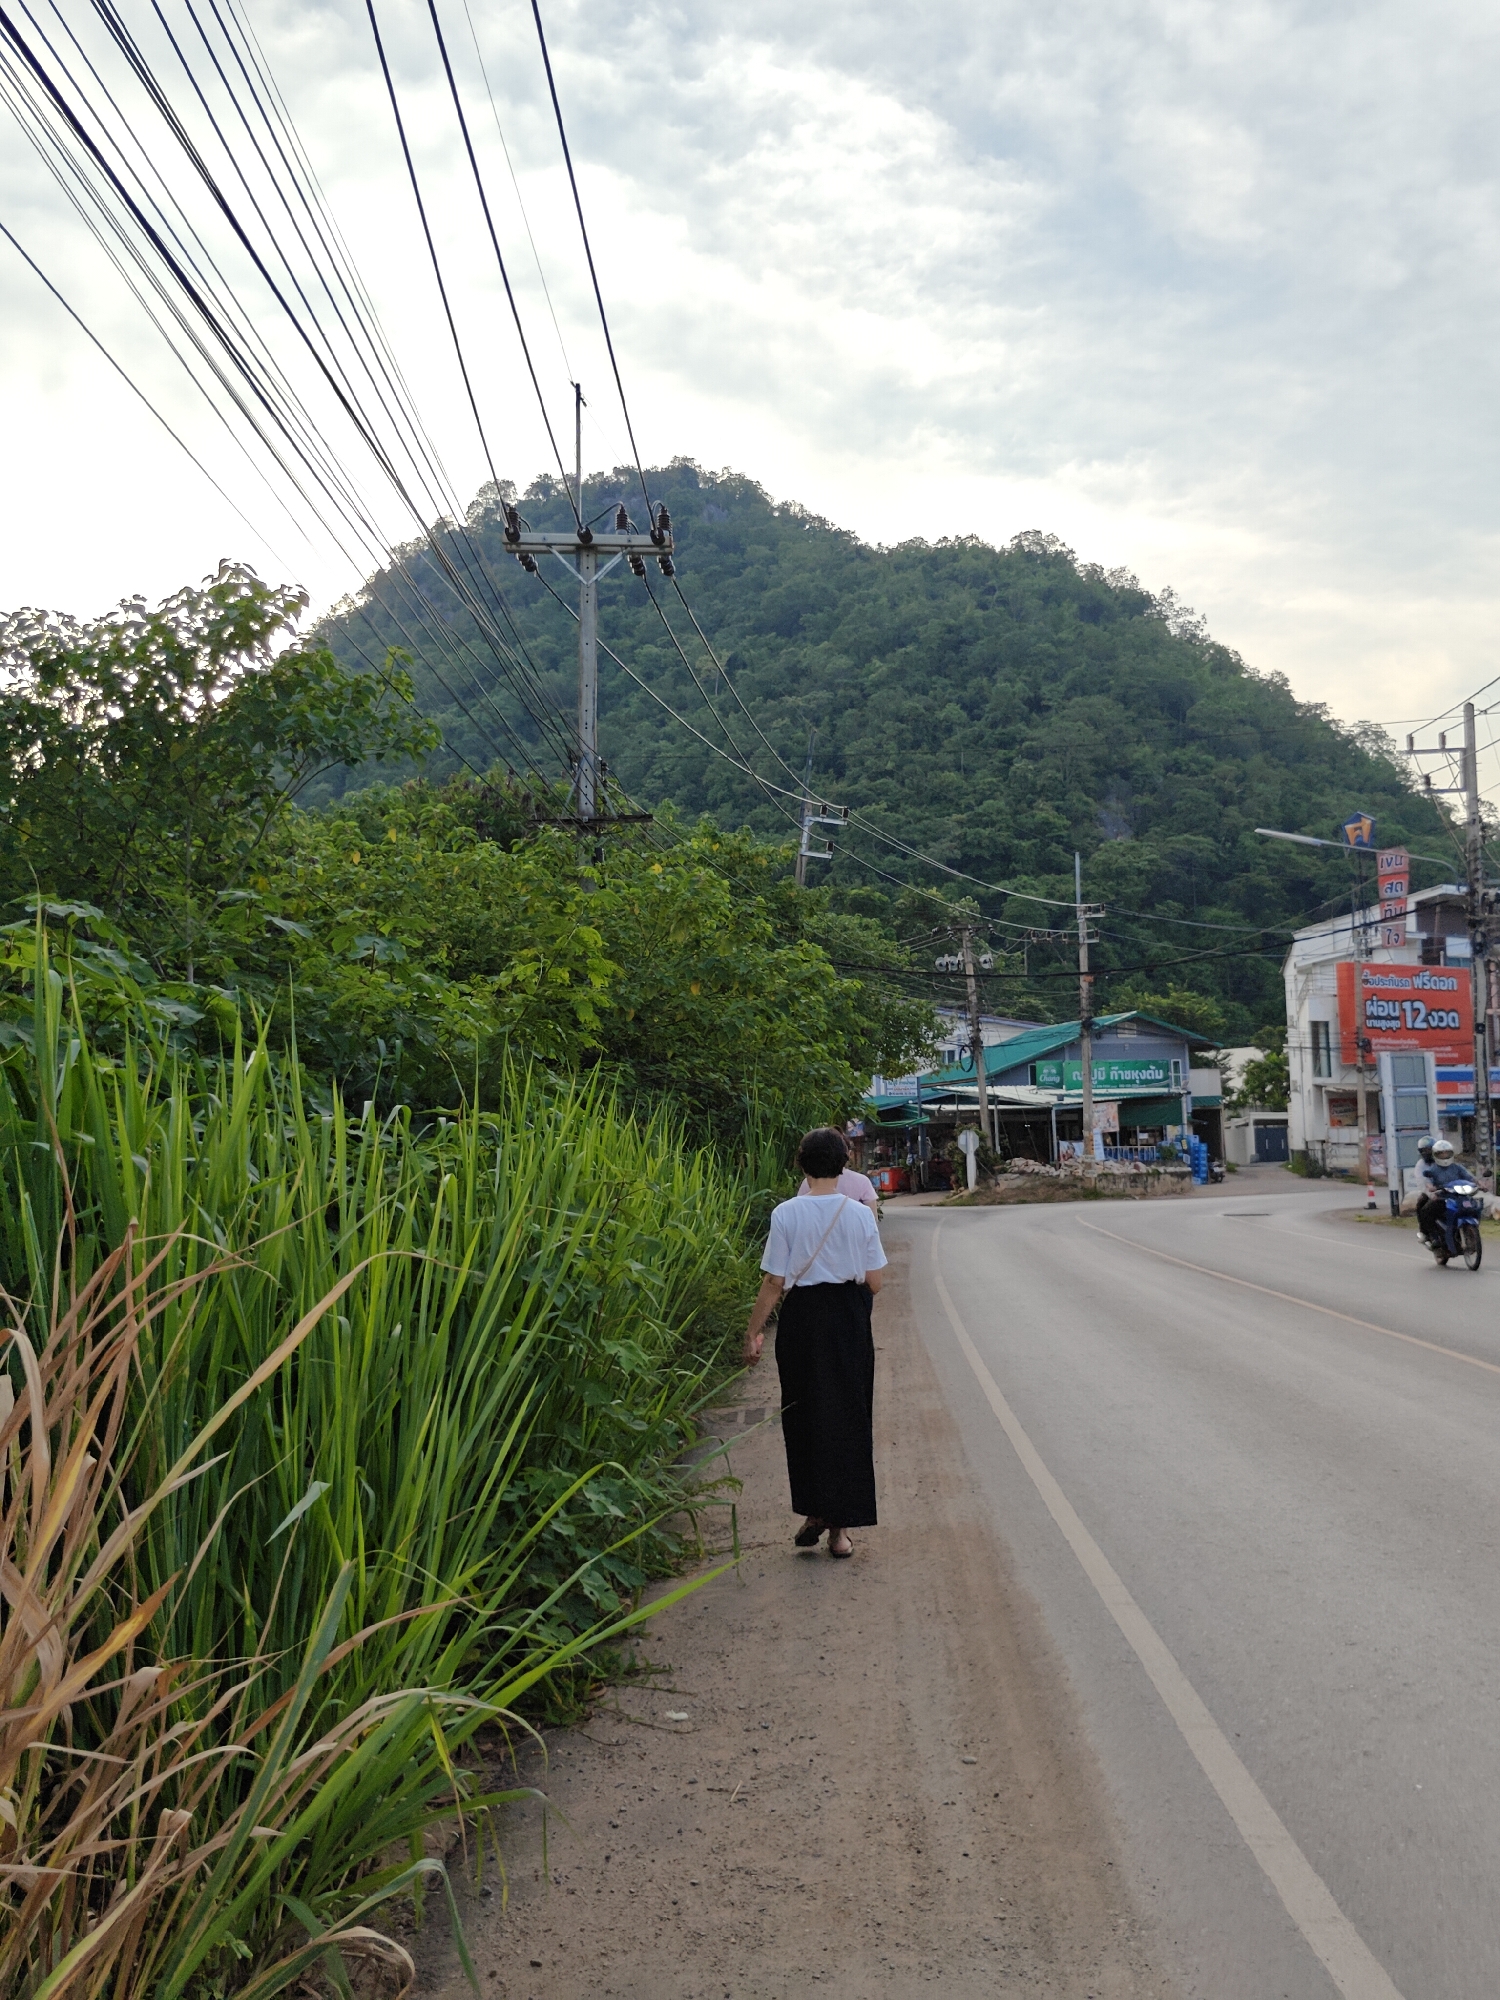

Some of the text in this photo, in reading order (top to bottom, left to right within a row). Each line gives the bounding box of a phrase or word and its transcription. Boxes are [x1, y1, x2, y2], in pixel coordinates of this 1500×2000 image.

[1365, 995, 1401, 1017] ผ่อน
[1401, 1000, 1428, 1029] 12
[1039, 1073, 1061, 1083] Chang
